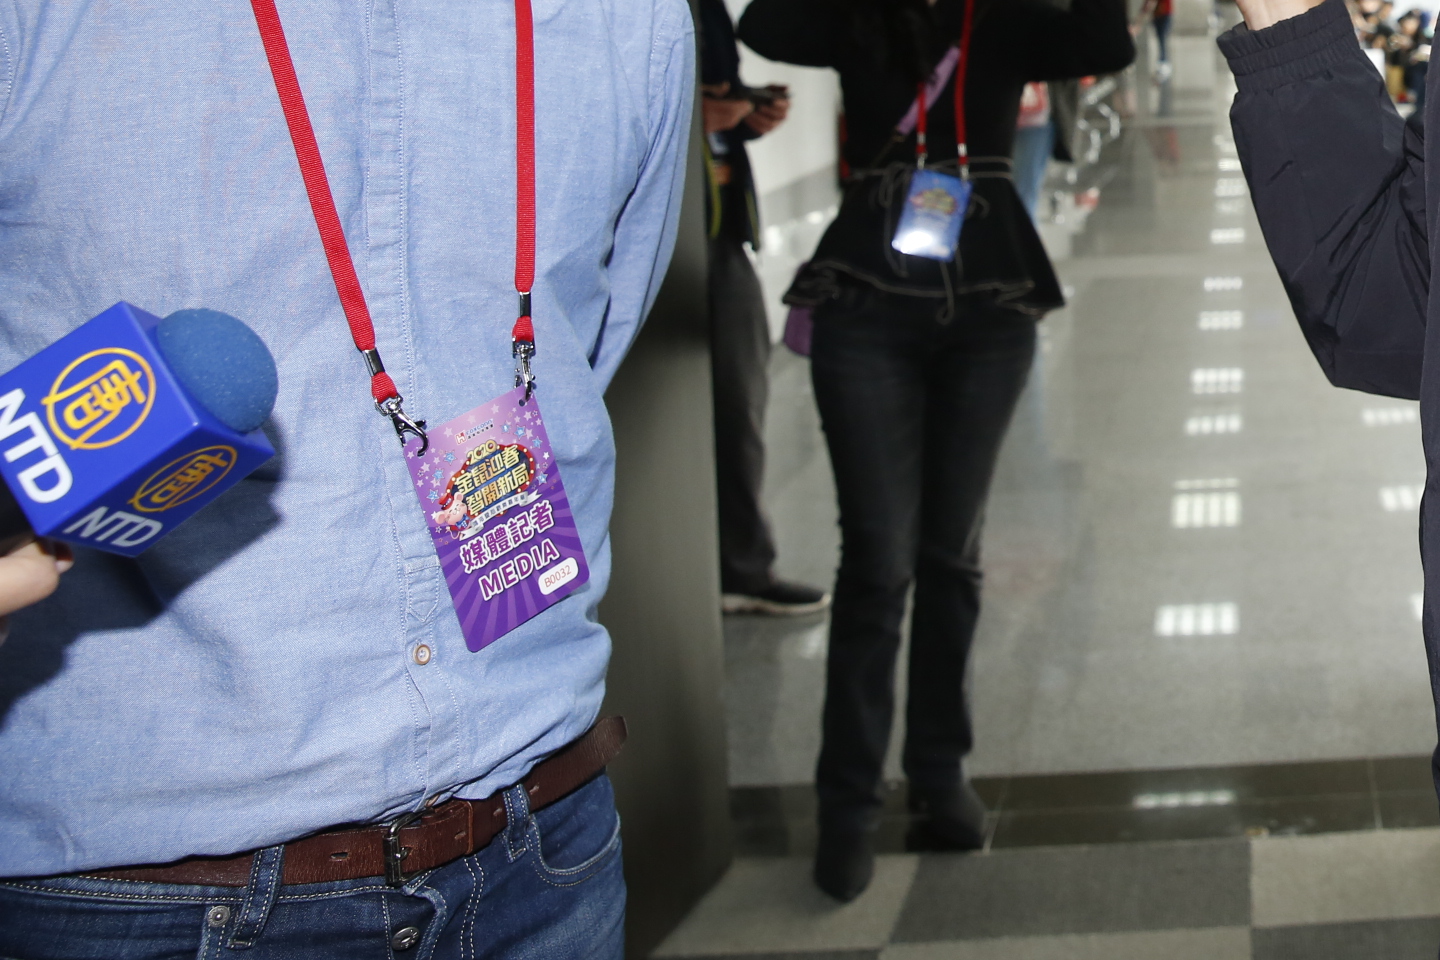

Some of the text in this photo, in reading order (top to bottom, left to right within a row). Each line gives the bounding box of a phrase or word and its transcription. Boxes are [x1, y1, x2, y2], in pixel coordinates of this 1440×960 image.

[0, 387, 73, 504] NTD
[466, 439, 498, 465] 2020
[466, 463, 530, 516] 智開新局
[62, 506, 163, 547] NTD
[461, 501, 553, 573] 媒體記者
[480, 540, 558, 599] MEDIA
[544, 564, 572, 588] B0032
